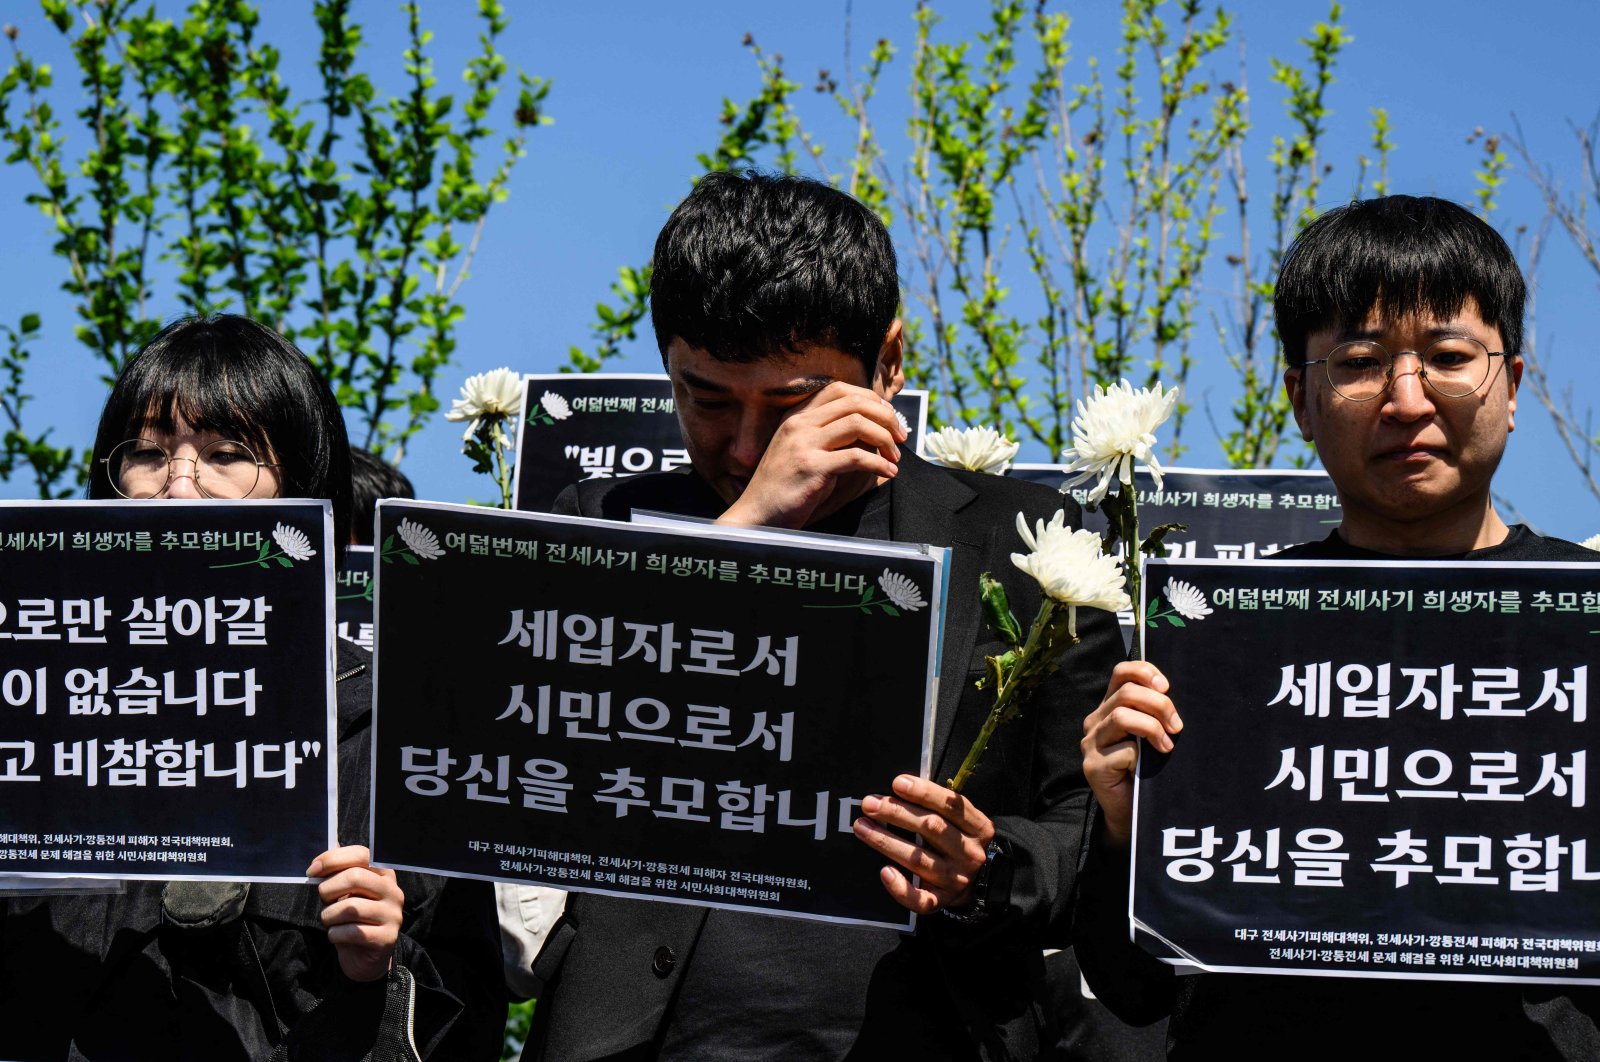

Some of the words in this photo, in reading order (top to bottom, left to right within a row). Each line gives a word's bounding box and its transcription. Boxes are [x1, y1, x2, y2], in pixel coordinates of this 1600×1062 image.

[572, 396, 637, 413] 여덟번째
[640, 397, 677, 414] 전세
[1203, 492, 1274, 510] 희생자를
[0, 531, 64, 551] 세사기
[71, 531, 153, 552] 희생자를
[160, 531, 264, 551] 추모합니다
[445, 532, 538, 560] 여덟번째
[546, 543, 637, 571] 전세사기
[645, 553, 740, 583] 희생자를
[747, 564, 867, 595] 추모합니다
[0, 596, 111, 643] 로만
[121, 596, 272, 645] 살아갈
[1212, 587, 1310, 611] 여덟번째
[1317, 589, 1413, 612] 전세사기
[1422, 590, 1522, 613] 희생자를
[497, 609, 799, 687] 세입자로서
[2, 667, 47, 715] 이
[64, 667, 262, 716] 없습니다
[1266, 661, 1588, 723] 세입자로서
[495, 684, 795, 762] 시민으로서
[53, 738, 321, 789] 비참합니다"
[400, 745, 574, 813] 당신을
[1264, 745, 1586, 808] 시민으로서
[40, 849, 60, 860] 문제
[62, 850, 92, 860] 해결을
[95, 850, 115, 861] 위한
[117, 851, 207, 862] 시민사회대책위원회
[128, 835, 158, 846] 피해자
[161, 835, 234, 848] 전국대책위원회,
[468, 840, 490, 852] 대구
[493, 843, 595, 865] 전세사기피해대책위,
[693, 867, 727, 880] 피해자
[730, 871, 811, 891] 전국대책위원회,
[1161, 825, 1350, 888] 당신을
[593, 871, 616, 883] 문제
[618, 874, 651, 888] 해결을
[654, 879, 677, 890] 위한
[680, 881, 780, 902] 시민사회대책위원회
[1234, 929, 1258, 941] 대구
[1262, 929, 1374, 945] 전세사기피해대책위,
[1481, 936, 1518, 950] 피해자
[1373, 951, 1397, 964] 문제
[1400, 952, 1436, 965] 해결을
[1440, 953, 1464, 966] 위한
[1467, 954, 1579, 970] 시민사회대책위원회
